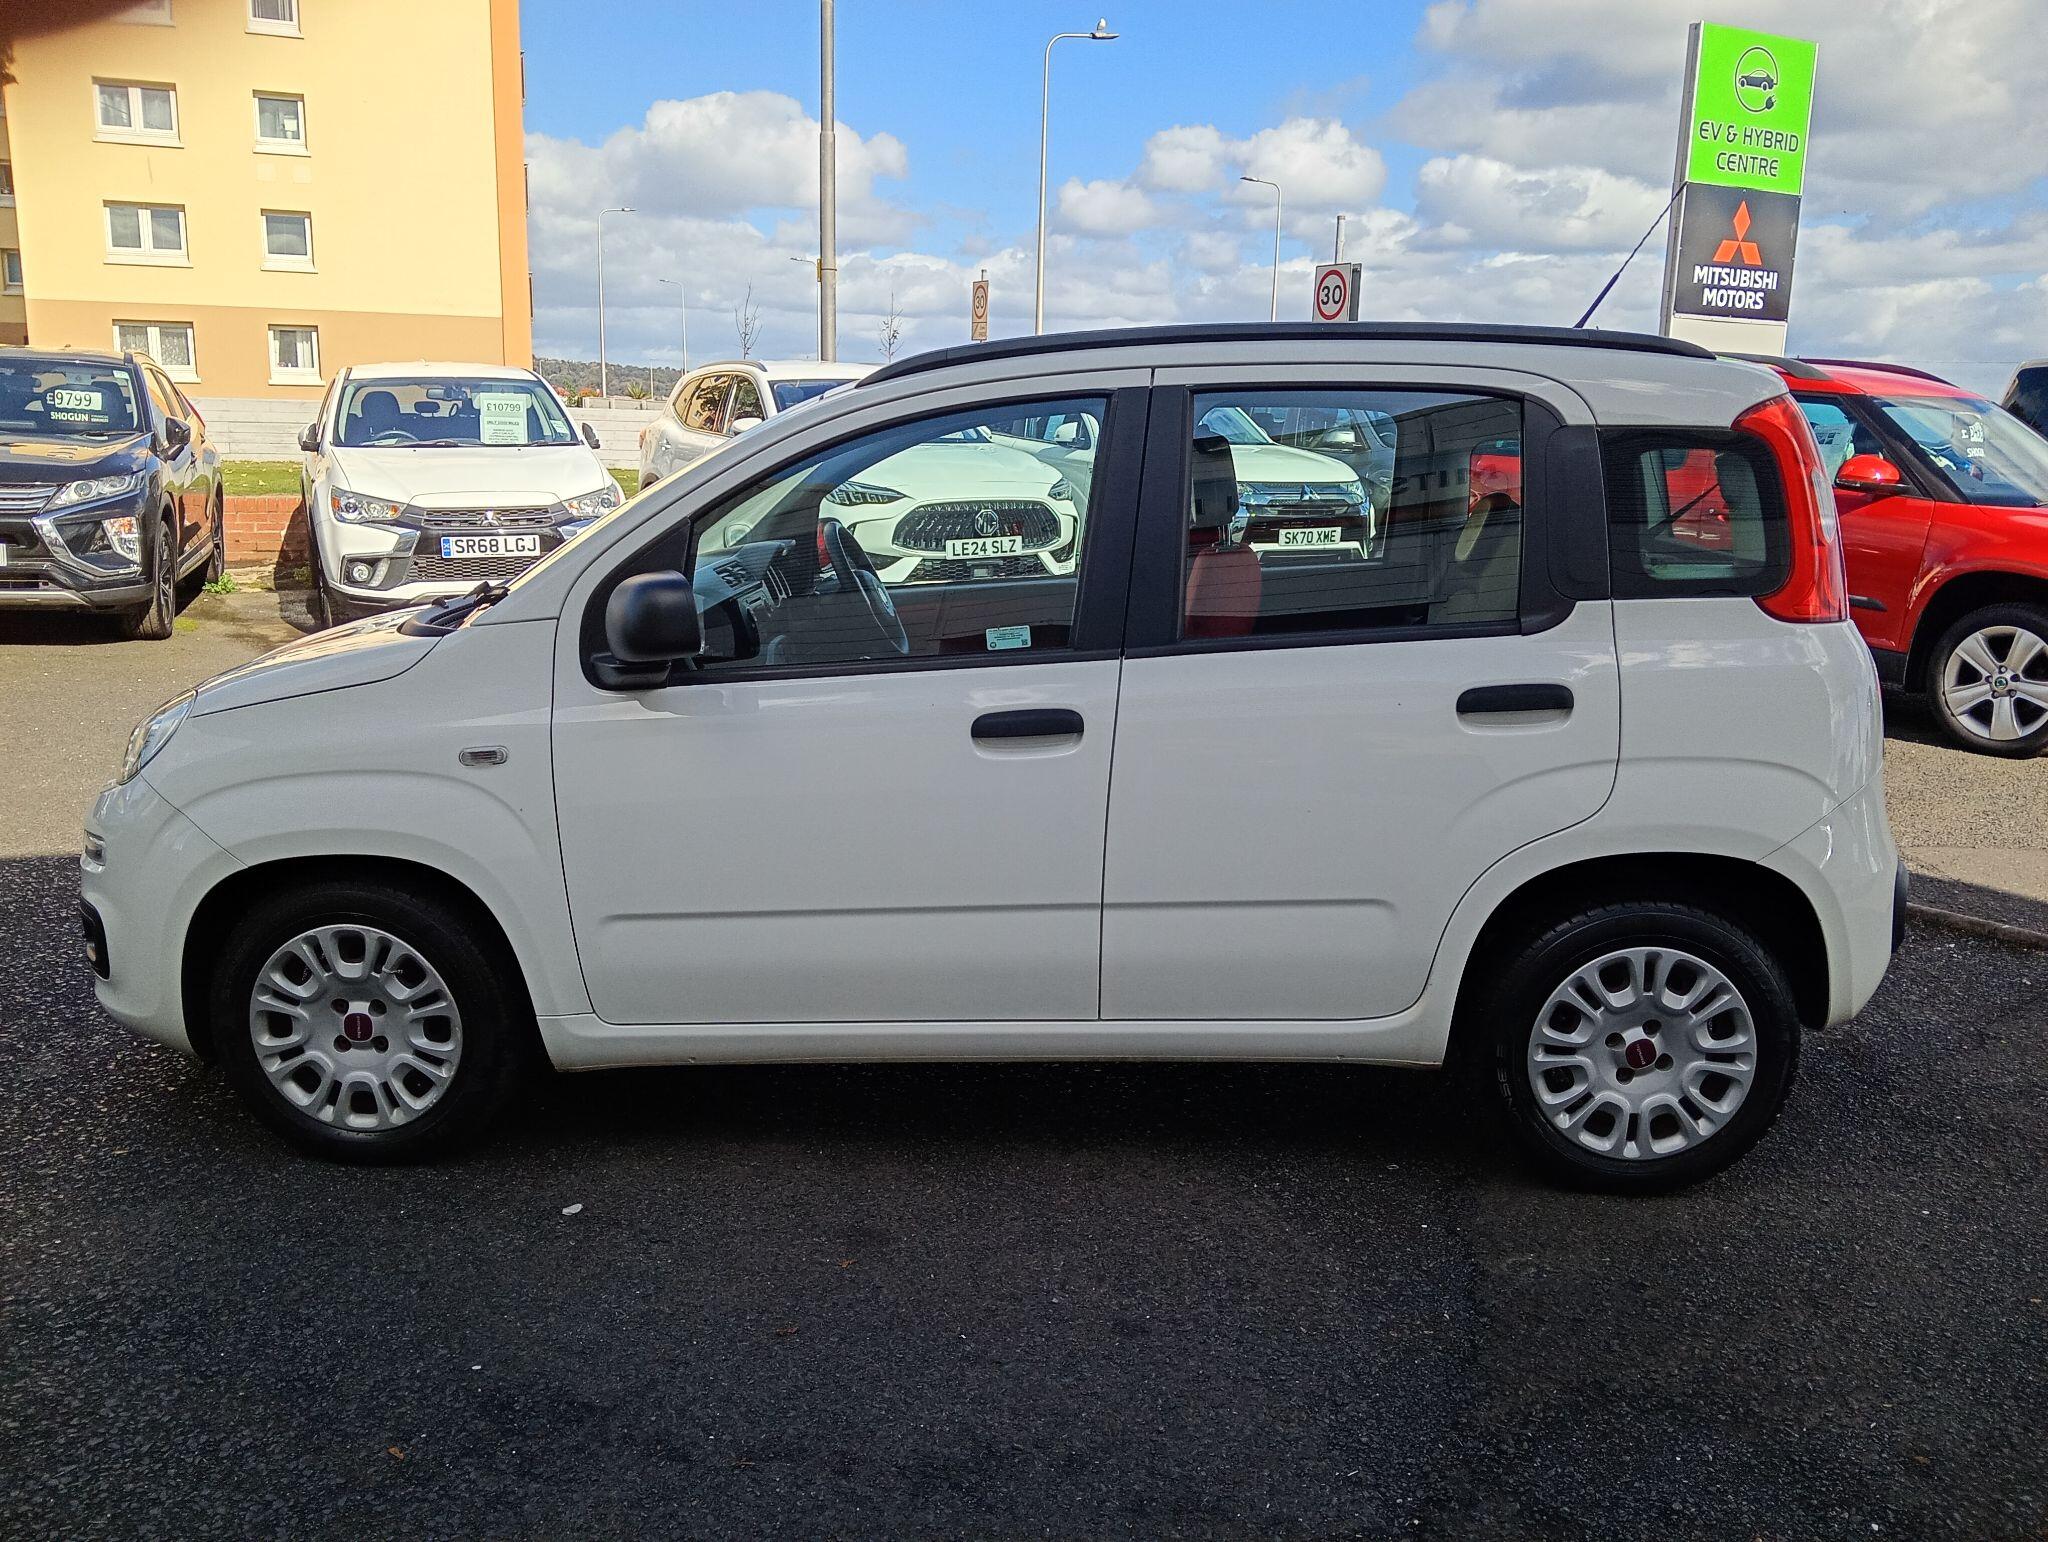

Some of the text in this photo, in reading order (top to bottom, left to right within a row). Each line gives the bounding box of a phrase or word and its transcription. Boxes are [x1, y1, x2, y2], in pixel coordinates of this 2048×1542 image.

[1699, 121, 1799, 153] EV & HYBRID
[1716, 152, 1779, 178] CENTRE
[1692, 265, 1779, 290] MITSUBISHI
[1320, 284, 1343, 306] 30
[1702, 288, 1765, 311] MOTORS
[50, 411, 90, 422] SHOGUN
[486, 402, 521, 412] £10799
[454, 537, 537, 554] SR68 LGJ
[1284, 530, 1337, 545] SK70 XME
[952, 539, 1017, 556] LE24 SLZ
